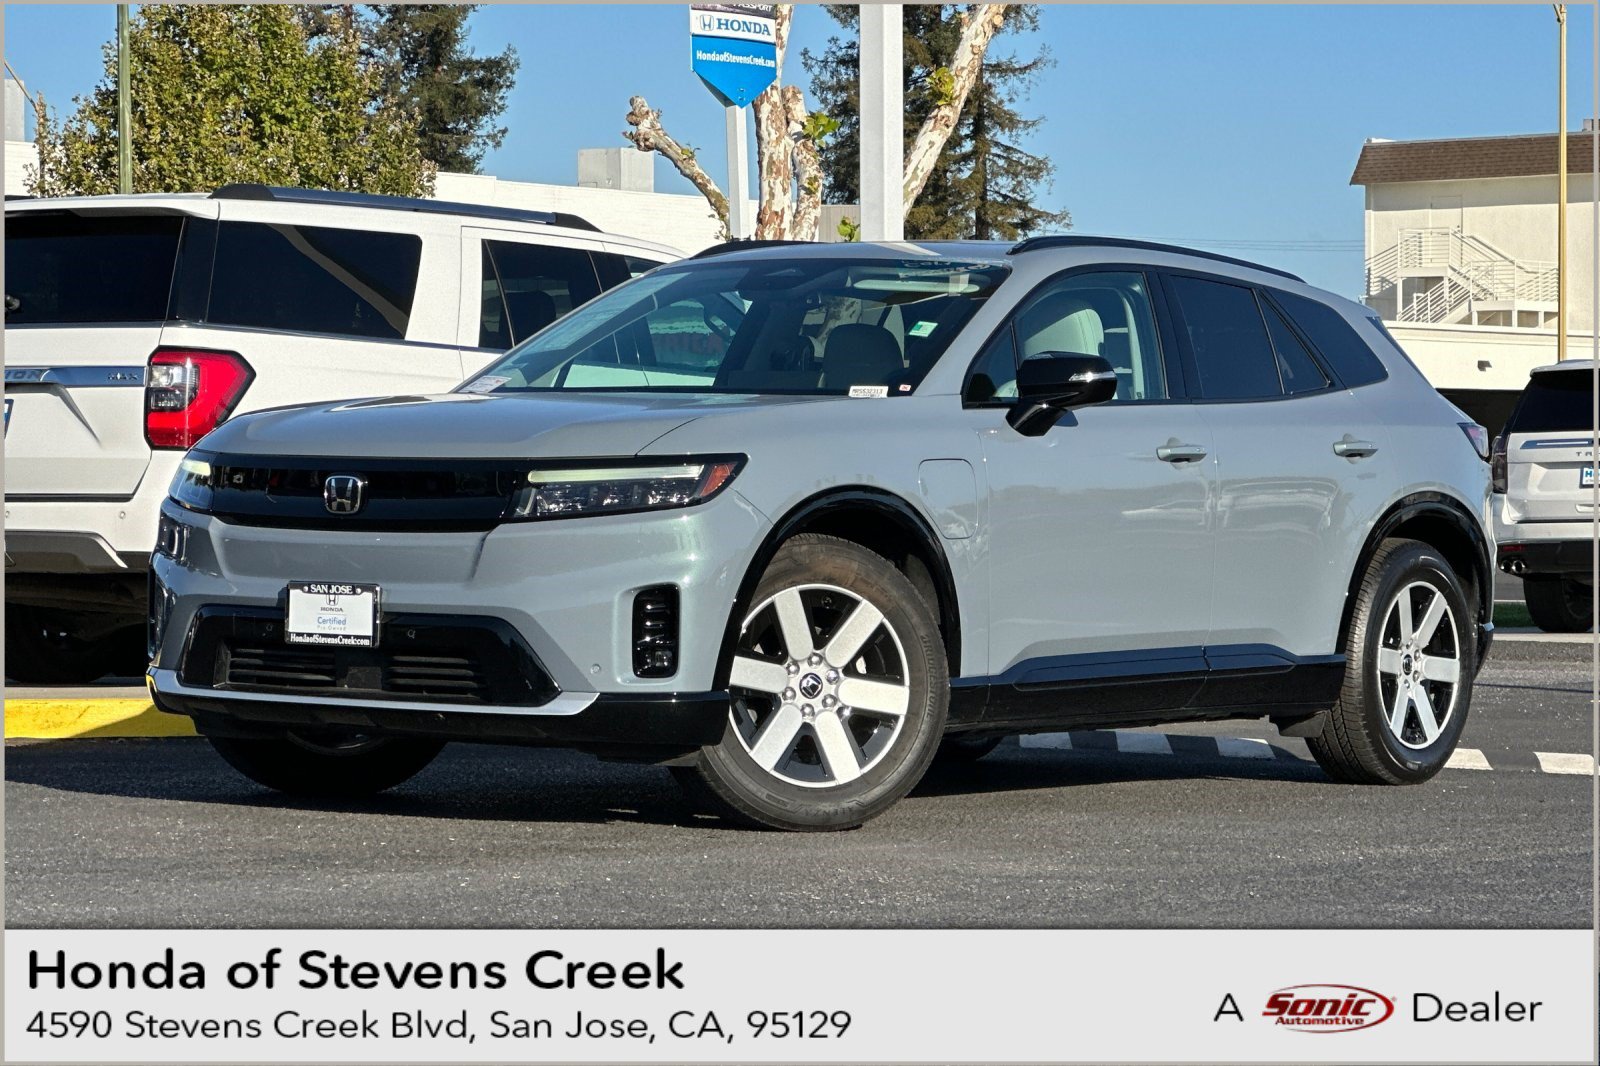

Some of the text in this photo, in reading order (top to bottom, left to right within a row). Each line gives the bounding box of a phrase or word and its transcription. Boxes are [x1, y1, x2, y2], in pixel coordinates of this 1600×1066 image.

[716, 18, 771, 36] HONDA
[696, 50, 776, 68] HondaofStevensCreek.com
[310, 584, 353, 595] SAN JOSE
[317, 617, 347, 625] Certified
[290, 633, 370, 646] HondaofStevensCreek.com
